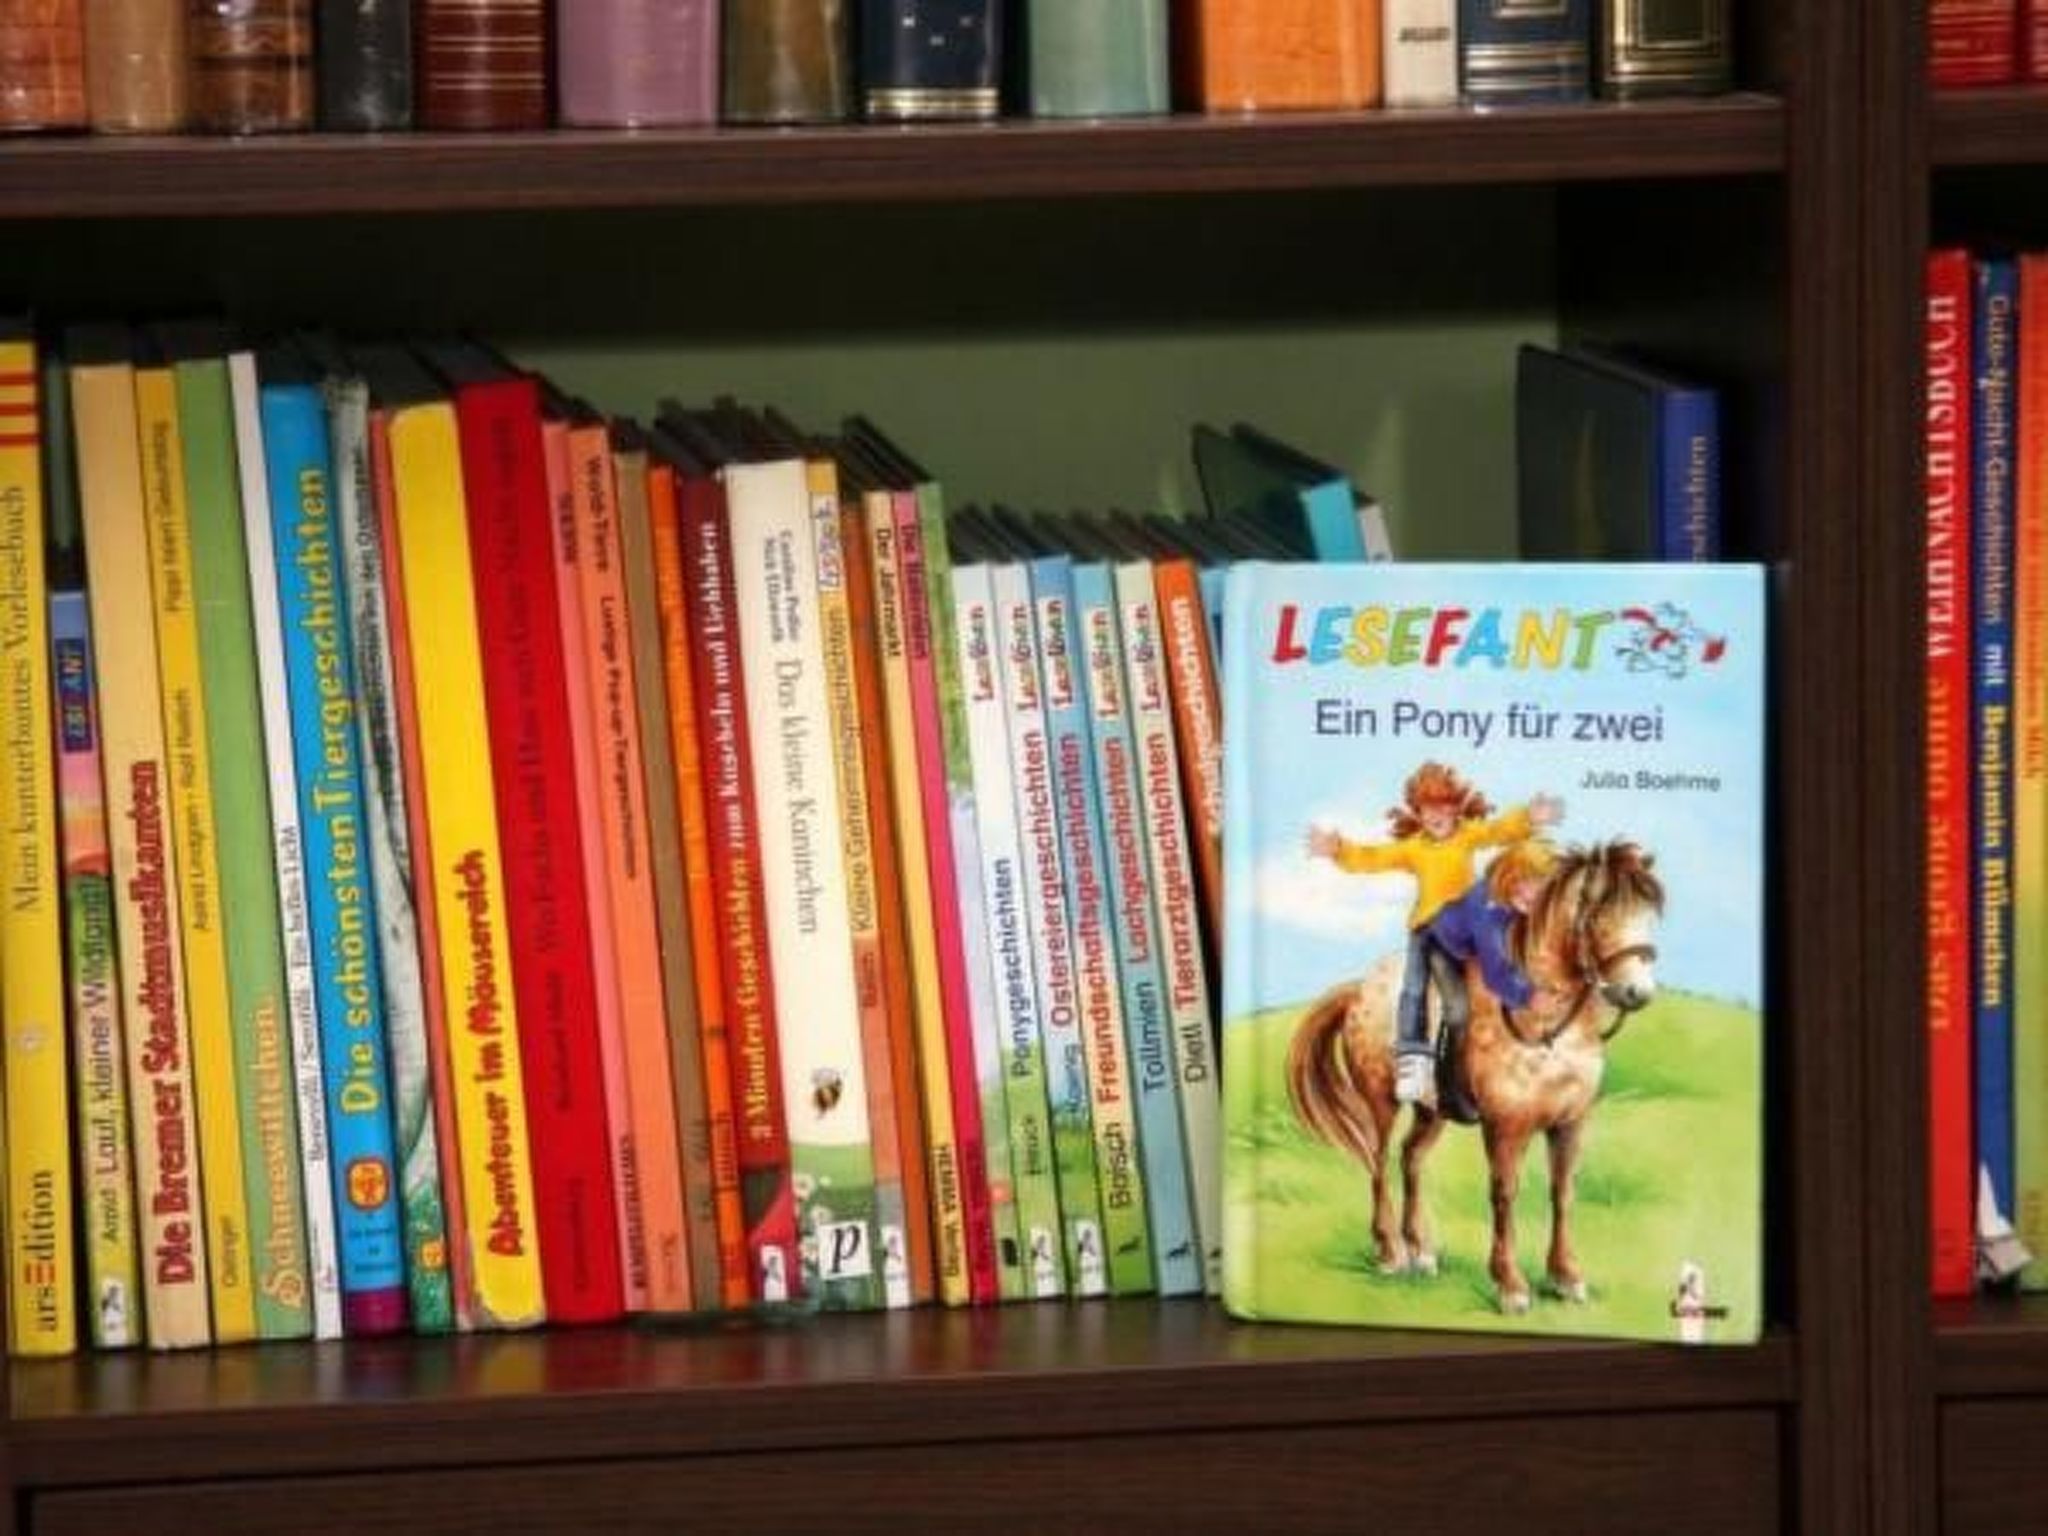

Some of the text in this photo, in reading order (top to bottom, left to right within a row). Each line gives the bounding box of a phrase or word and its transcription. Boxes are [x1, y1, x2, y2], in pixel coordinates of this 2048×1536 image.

[697, 522, 725, 634] Liebhaben
[1271, 602, 1616, 672] LESEFANT
[0, 485, 43, 914] Mein kunterbuntes Vorlesebuch
[706, 640, 730, 687] und
[710, 691, 742, 798] Kuscheln
[1315, 699, 1664, 749] Ein Pony für zwei
[290, 467, 382, 1114] Die schönsten Tiergeschichten
[726, 802, 748, 851] zum
[774, 658, 827, 934] Das kleine Kaninchen
[1580, 770, 1721, 793] Julia Boehme
[851, 861, 871, 932] Kleine
[1019, 731, 1074, 1028] Ostereiergeschichten
[1057, 732, 1122, 1106] Freundschaftsgeschichten
[1102, 736, 1168, 1094] Tollmien Lachgeschichten
[1142, 732, 1208, 1084] Dietl Tierarztgeschichten
[128, 759, 195, 1285] Die Bremer Stadtmusikanten
[991, 858, 1034, 1077] Ponygeschichten
[86, 1014, 113, 1104] kleiner
[452, 850, 525, 1257] Abenteuer im Mäusereich
[90, 1110, 121, 1176] Lauf,
[20, 1169, 58, 1334] arsEdition
